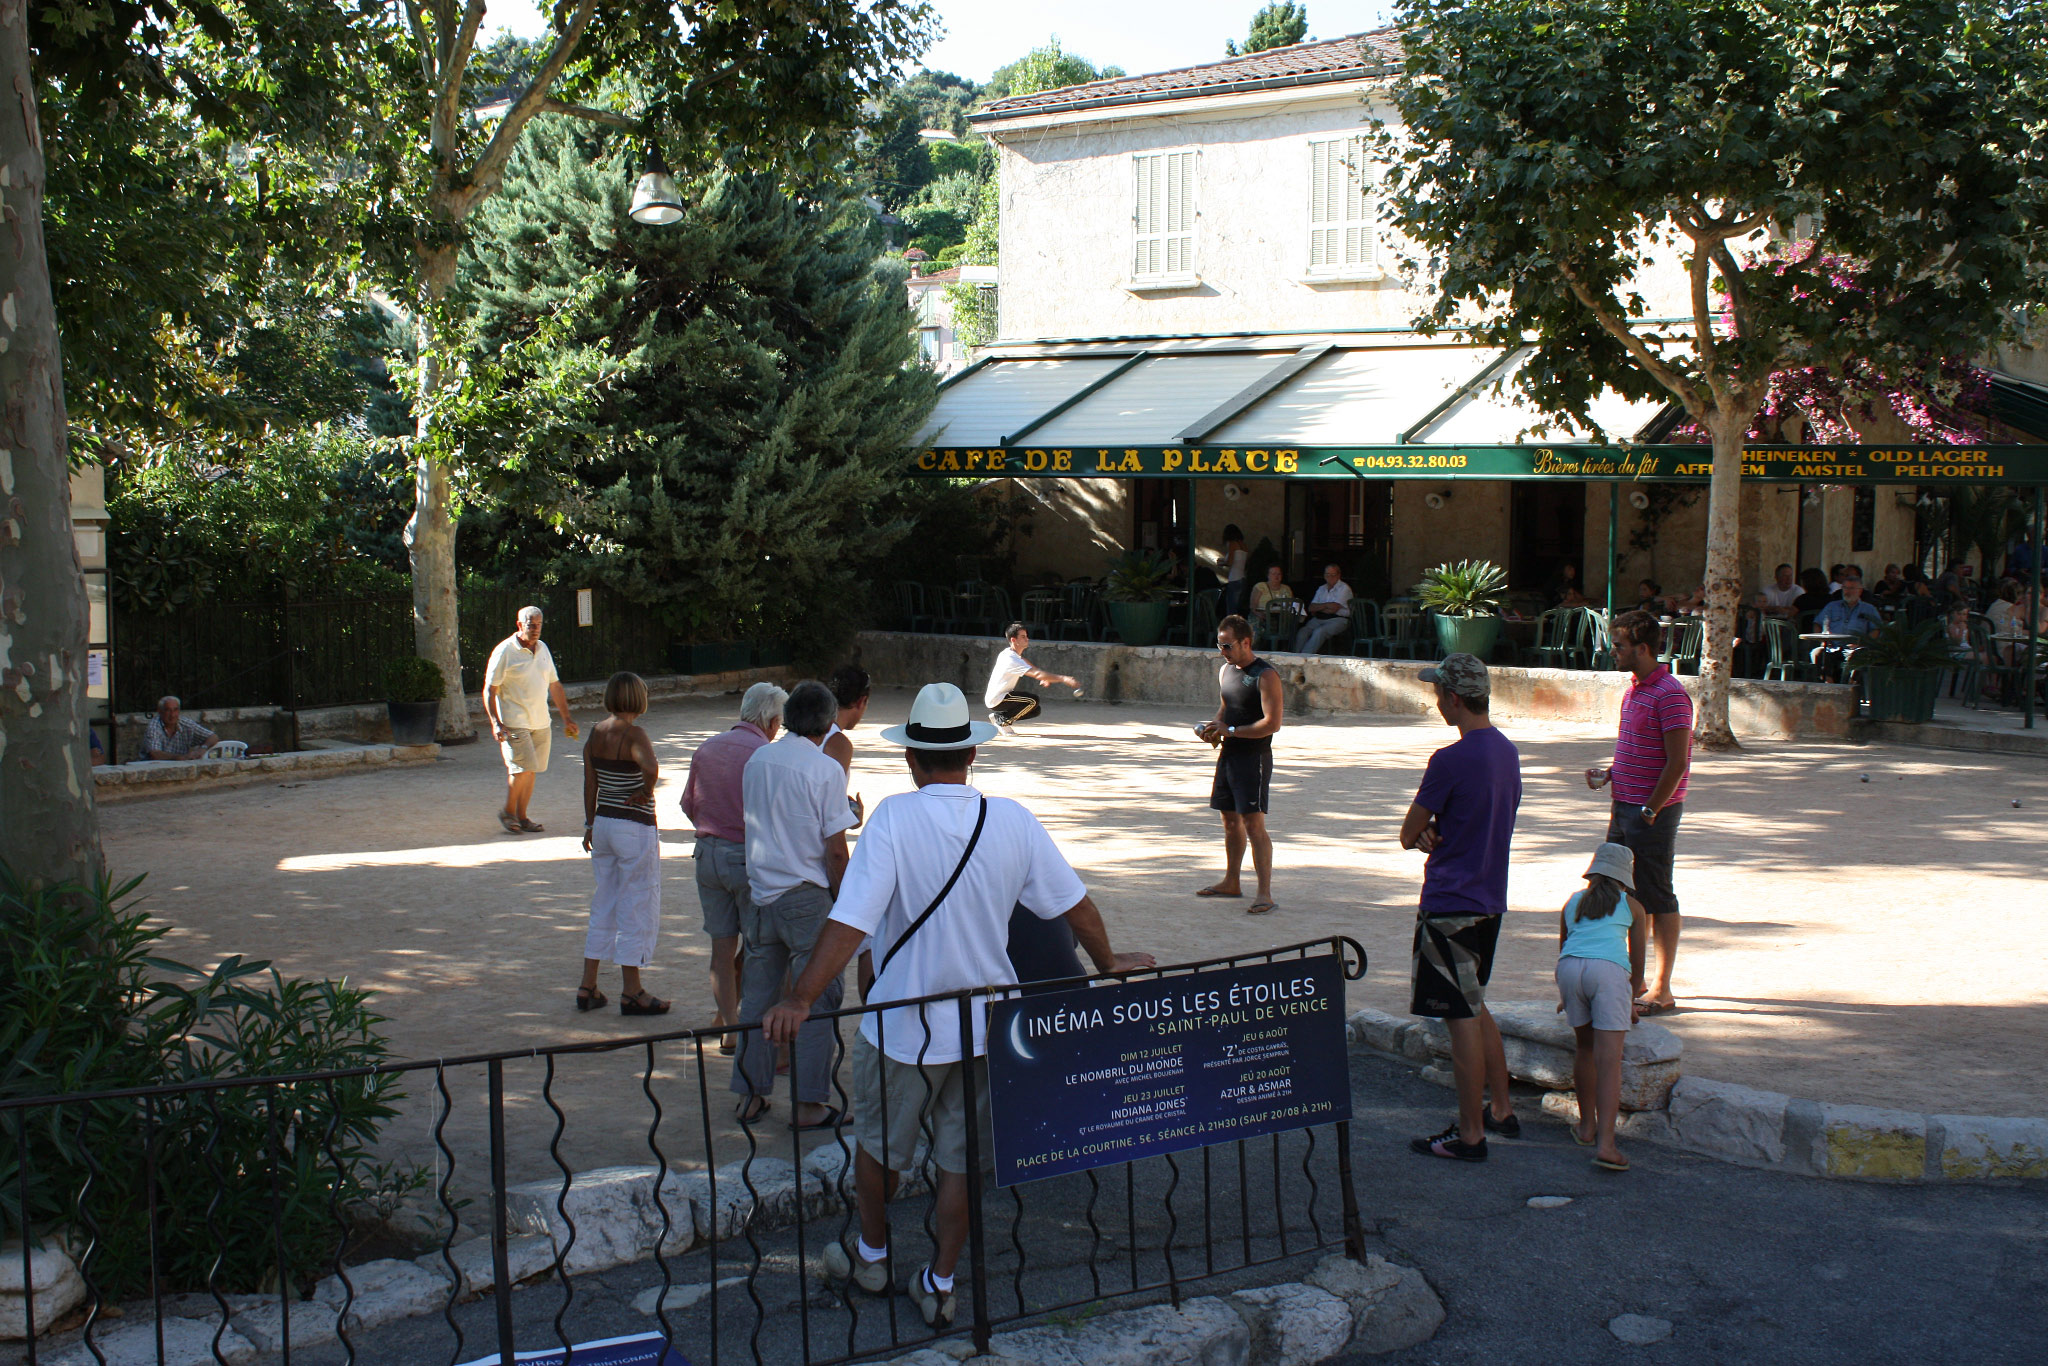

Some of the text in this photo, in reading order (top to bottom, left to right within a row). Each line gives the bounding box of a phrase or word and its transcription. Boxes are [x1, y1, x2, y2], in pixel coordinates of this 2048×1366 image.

[1024, 450, 1072, 471] DE
[1095, 450, 1144, 472] LA
[1162, 449, 1299, 473] PLACE
[1366, 455, 1467, 468] 04.93.32.80.03
[1533, 448, 1660, 482] Bières tirées du fût
[1741, 450, 1989, 462] HEINEKEN OLD LAGER
[1790, 464, 1868, 476] AMSTEL
[1895, 465, 2004, 477] PELFORTH
[1113, 998, 1173, 1024] SOUS
[1182, 991, 1220, 1014] LES
[1229, 977, 1316, 1007] ÉTOILES
[1157, 1011, 1249, 1036] SAINT-PAUL
[1255, 1005, 1274, 1020] DE
[1280, 998, 1328, 1016] VENCE
[1242, 1027, 1288, 1042] JEU 6 AOÛT
[1120, 1044, 1182, 1062] DIM 12 JUILLET
[1203, 1058, 1231, 1069] PRÉSENTÉ
[1232, 1056, 1244, 1064] PAR
[1262, 1050, 1289, 1060] SEMPRUN
[1246, 1046, 1265, 1054] COSTA
[1066, 1056, 1184, 1085] LE NOMBRIL DU MONDE
[1114, 1077, 1130, 1085] AVEC
[1130, 1073, 1152, 1083] MICHEL
[1239, 1065, 1291, 1083] JEU 20 AOÛT
[1122, 1085, 1185, 1104] JEU 23 JUILLET
[1220, 1078, 1292, 1099] AZUR & ASMAR
[1236, 1095, 1257, 1104] DESSIN
[1257, 1091, 1276, 1100] ANIMÉ
[1282, 1089, 1292, 1097] 21H
[1111, 1098, 1186, 1120] INDIANA JONES
[1087, 1125, 1095, 1133] LE
[1095, 1120, 1124, 1131] ROYAUME
[1163, 1110, 1186, 1119] CRISTAL
[1016, 1153, 1047, 1168] PLACE
[1051, 1150, 1064, 1161] DE
[1067, 1147, 1080, 1158] LA
[1082, 1137, 1136, 1155] COURTINE.
[1157, 1125, 1196, 1141] SÉANCE
[1198, 1121, 1205, 1133] À
[1208, 1118, 1237, 1132] 21H30
[1239, 1111, 1269, 1127] (SAUF
[1270, 1105, 1299, 1120] 20/08
[1302, 1103, 1309, 1114] À
[1311, 1100, 1332, 1113] 21H)
